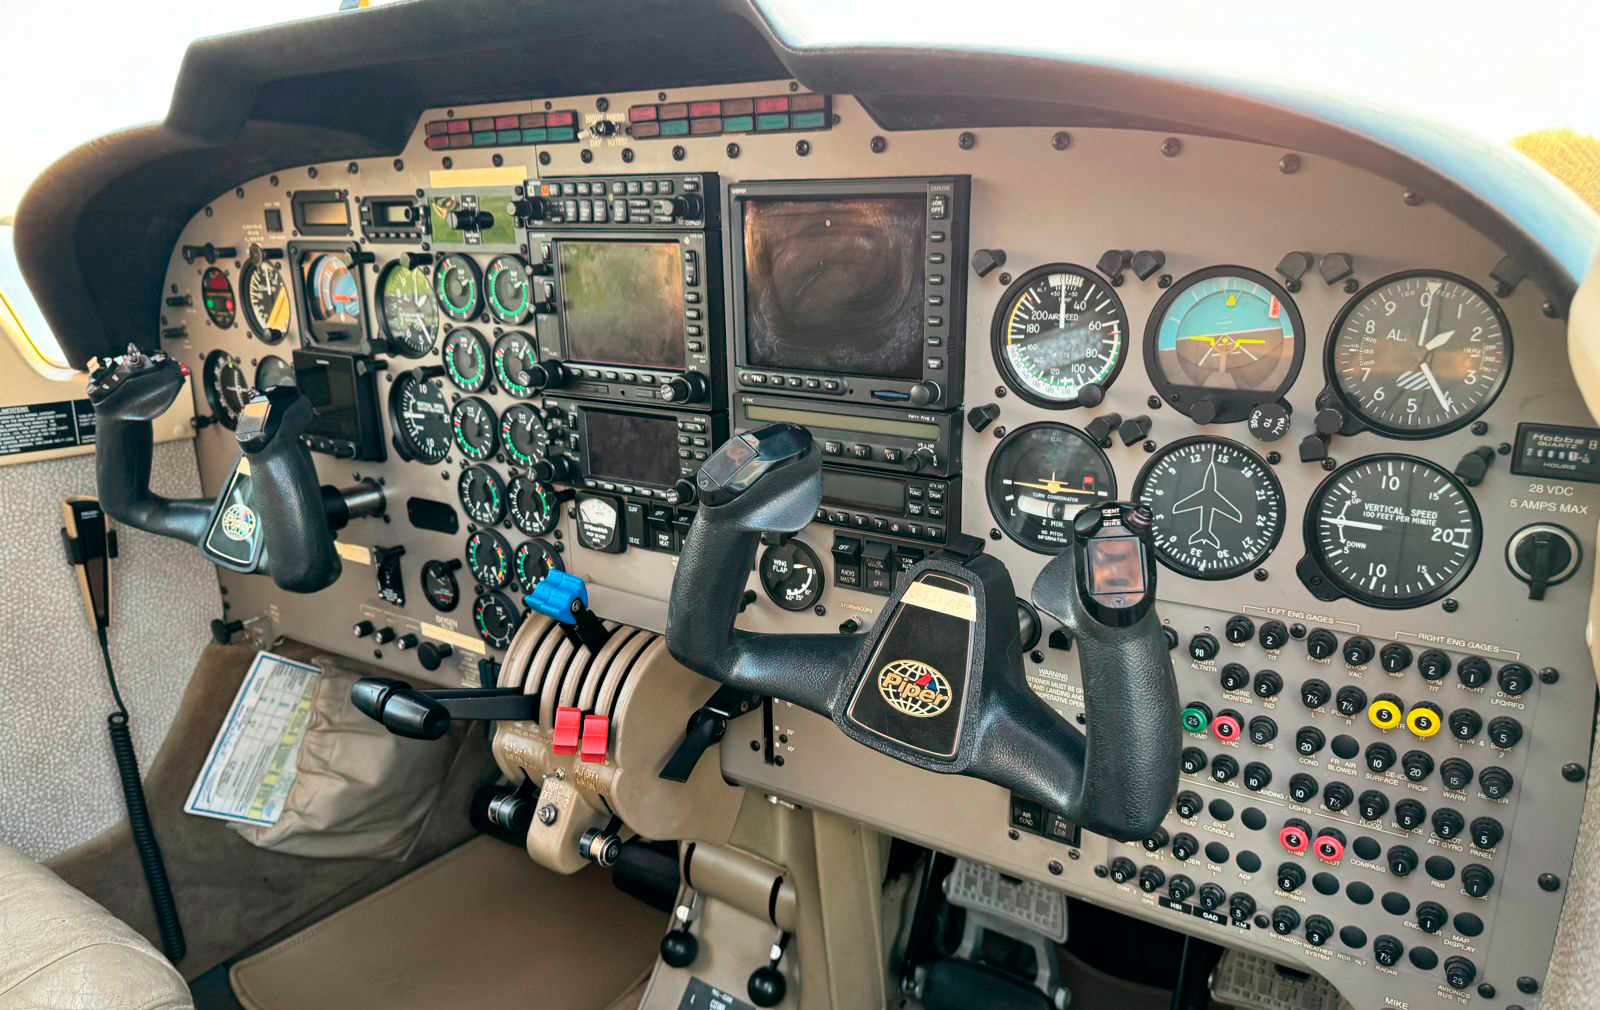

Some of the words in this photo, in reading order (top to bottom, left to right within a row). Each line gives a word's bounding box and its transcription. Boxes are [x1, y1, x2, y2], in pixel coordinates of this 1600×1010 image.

[1074, 301, 1086, 310] 40
[1385, 301, 1396, 316] 9
[1032, 311, 1049, 320] 200
[1026, 324, 1039, 333] 180
[1089, 321, 1101, 331] 60
[1365, 320, 1375, 334] 8
[1471, 327, 1483, 341] 2
[1086, 349, 1098, 358] 80
[1071, 364, 1086, 373] 100
[1361, 368, 1371, 382] 7
[1464, 370, 1476, 385] 3
[419, 384, 428, 394] 10
[1374, 387, 1385, 401] 6
[1407, 398, 1417, 413] 5
[1251, 410, 1262, 429] CAGE
[1263, 418, 1273, 428] TO
[1272, 418, 1285, 435] PULL
[426, 438, 435, 447] 10
[1532, 434, 1585, 445] Hobbs
[825, 444, 837, 453] REV
[855, 448, 866, 457] ALT
[886, 452, 895, 461] VS
[1190, 454, 1201, 464] 12
[1217, 455, 1229, 464] 15
[1543, 462, 1576, 470] HOURS
[1241, 466, 1254, 478] 18
[1382, 475, 1400, 491] 10
[1529, 484, 1544, 494] 28
[1546, 486, 1574, 496] VDC
[1047, 494, 1079, 503] COORDINATOR
[1256, 490, 1266, 501] 21
[1429, 492, 1439, 501] 15
[1364, 503, 1404, 516] VERTICAL
[1411, 509, 1438, 519] SPEED
[1510, 499, 1518, 508] 5
[1520, 500, 1556, 512] AMPS
[1559, 504, 1589, 514] MAX
[1103, 519, 1122, 527] MIKE
[1256, 515, 1267, 527] 24
[1396, 515, 1410, 523] PER
[1412, 517, 1437, 526] MINUTE
[1038, 535, 1067, 543] INFORMATION
[1431, 528, 1454, 543] 20
[659, 539, 670, 547] HEAT
[1242, 536, 1254, 549] 27
[1346, 541, 1367, 549] DOWN
[1190, 548, 1203, 557] 33
[1217, 549, 1230, 558] 30
[773, 559, 788, 567] WING
[772, 565, 788, 574] FLAP
[841, 569, 855, 577] RADIO
[1368, 563, 1387, 578] 10
[1417, 565, 1427, 573] 15
[1267, 608, 1286, 616] LEFT
[1288, 611, 1305, 619] ENG
[1306, 614, 1334, 624] GAGES
[1418, 633, 1446, 643] RIGHT
[1447, 638, 1466, 647] ENG
[1467, 641, 1500, 653] GAGES
[1195, 648, 1204, 657] 90
[1191, 663, 1217, 672] ALTNTR
[1039, 668, 1069, 680] WARNING
[1348, 671, 1362, 680] VAC
[882, 673, 949, 706] Piper
[1051, 681, 1068, 690] MUST
[1429, 685, 1440, 693] TIT
[1046, 688, 1071, 697] LANDING
[1071, 693, 1084, 701] AND
[1223, 694, 1253, 704] MONITOR
[1490, 698, 1525, 710] LFQ/RFQ
[1189, 717, 1198, 725] 25
[1256, 733, 1263, 741] 15
[1301, 743, 1312, 752] 20
[1185, 762, 1193, 770] 10
[1299, 758, 1319, 767] COND
[1345, 761, 1357, 769] AIR
[1373, 760, 1382, 768] 10
[1217, 771, 1225, 779] 10
[1328, 765, 1357, 776] BLOWER
[1410, 768, 1422, 777] 20
[1365, 773, 1399, 786] SURFACE
[1450, 777, 1460, 786] 15
[1408, 783, 1428, 792] PROP
[1489, 786, 1498, 795] 15
[1257, 790, 1285, 800] LANDING
[1443, 791, 1467, 802] WARN
[1182, 807, 1189, 815] 15
[1288, 804, 1313, 815] LIGHTS
[1181, 819, 1197, 827] HEAT
[1359, 820, 1383, 830] FLOOD
[1203, 825, 1235, 838] CONSOLE
[1441, 842, 1464, 852] GYRO
[1469, 849, 1494, 860] PANEL
[1350, 858, 1386, 873] COMPASS
[1117, 884, 1130, 892] COM
[1431, 881, 1446, 889] RMI
[1274, 890, 1306, 904] AMP/MKR
[1203, 912, 1219, 922] GAD
[1269, 932, 1302, 946] SKYWATCH
[1303, 943, 1333, 956] WEATHER
[1453, 935, 1470, 944] MAP
[1444, 939, 1477, 953] DISPLAY
[1304, 950, 1330, 961] SYSTEM
[1376, 965, 1398, 976] RADAR
[1453, 976, 1464, 985] 25
[1438, 985, 1471, 999] AVIONICS
[1438, 991, 1453, 1001] BUS
[1457, 997, 1468, 1005] TIE
[1385, 997, 1409, 1010] MIKE
